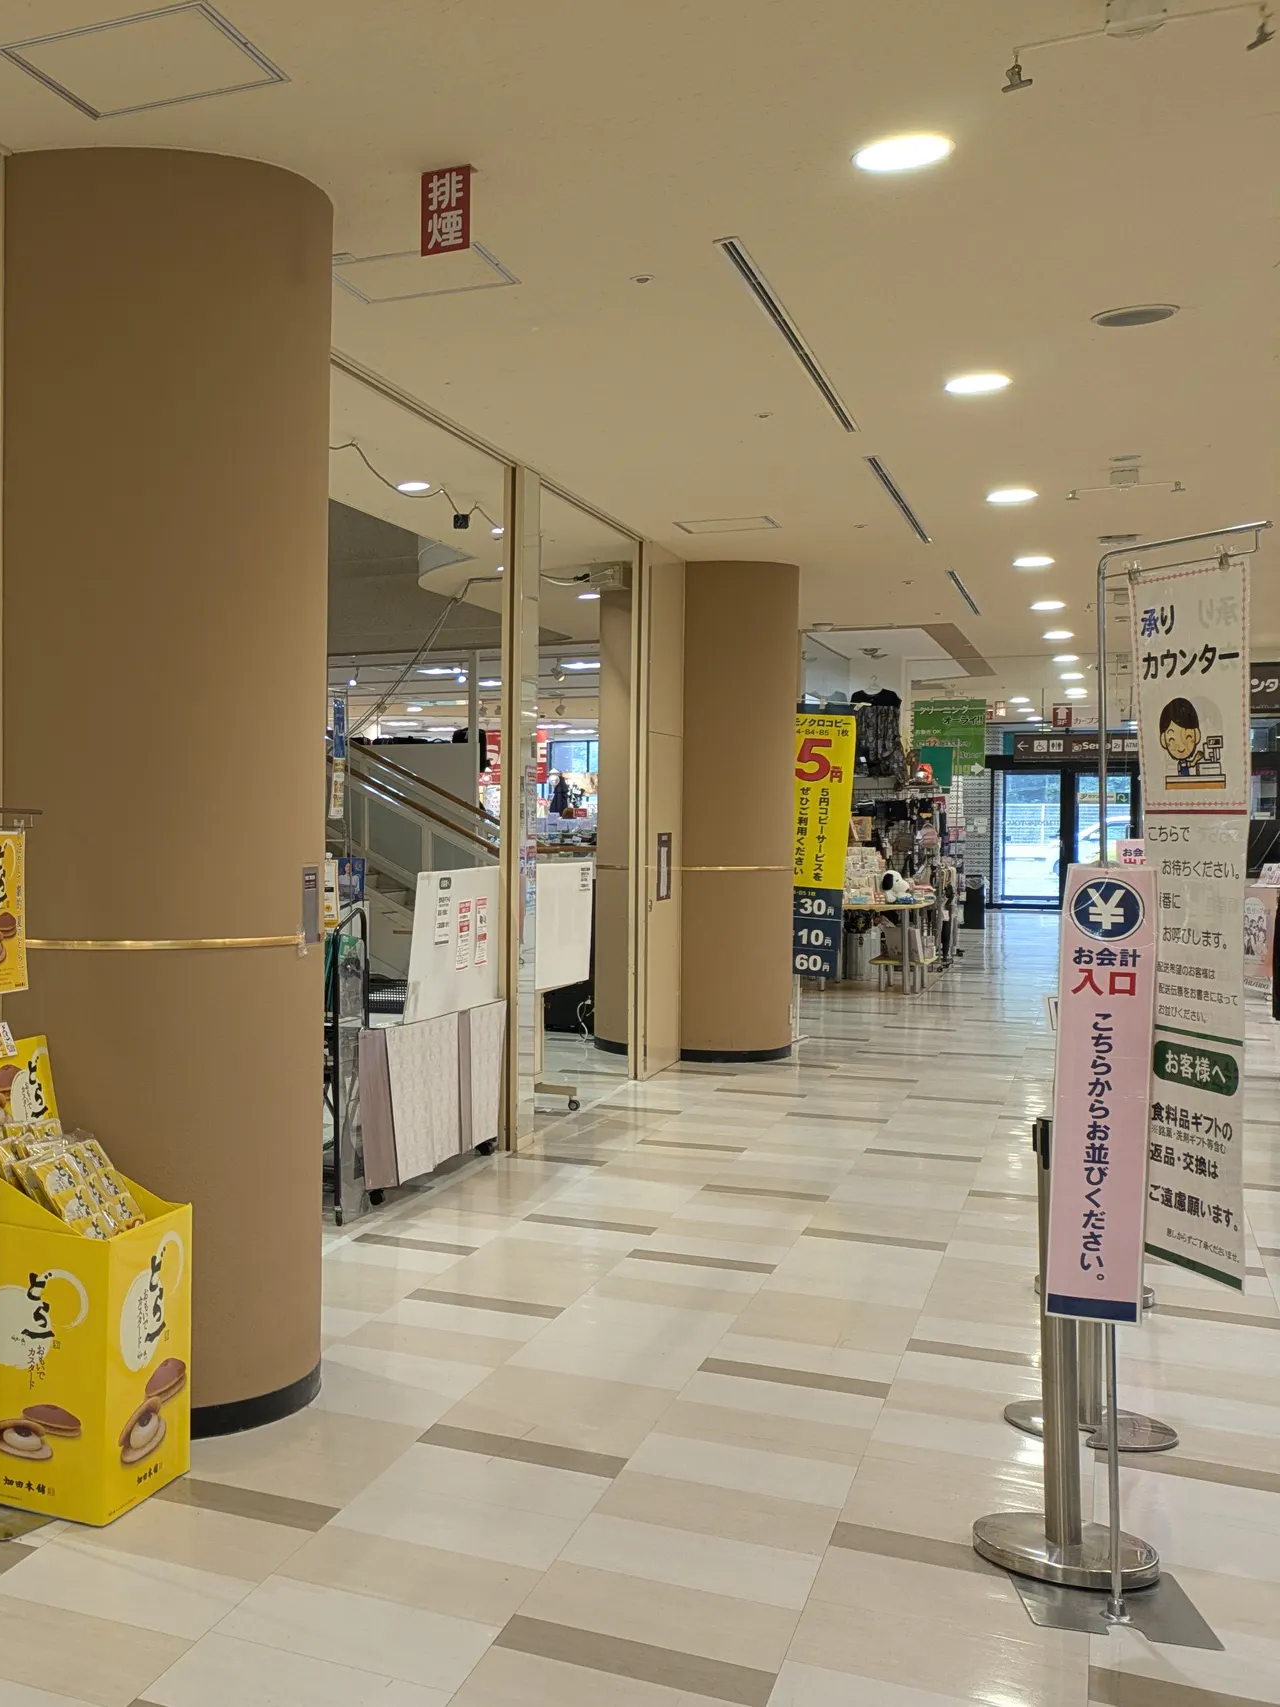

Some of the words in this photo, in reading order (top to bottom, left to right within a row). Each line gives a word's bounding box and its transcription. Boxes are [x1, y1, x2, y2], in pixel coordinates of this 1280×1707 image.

[428, 171, 464, 249] 排煙
[1140, 604, 1175, 638] 承り
[1142, 643, 1240, 681] カウンター
[919, 705, 970, 715] クリーニング
[795, 738, 843, 783] 5円
[1082, 741, 1111, 750] Ser
[793, 786, 812, 876] ぜひご利用ください
[812, 787, 830, 882] 5円コピーサービスを
[1147, 825, 1191, 843] こちらで
[1161, 858, 1240, 880] お待ちください。
[799, 898, 835, 916] 30円
[1086, 888, 1126, 930] ¥
[1159, 891, 1181, 909] 番に
[797, 928, 832, 946] 10円
[1162, 926, 1227, 950] お呼びします。
[795, 953, 830, 972] 60円
[1072, 946, 1141, 968] お会計
[1071, 968, 1137, 997] 入口
[1158, 1004, 1206, 1024] お並びください。
[1164, 1049, 1226, 1084] お客様へ
[1151, 1101, 1233, 1142] 食料品ギフトの
[1079, 1012, 1114, 1281] こちらからお並びください。
[1149, 1142, 1219, 1180] 返品・交換は
[1148, 1183, 1239, 1232] ご遠慮願います。
[27, 1347, 36, 1391] カスタード
[36, 1344, 46, 1380] おもいで
